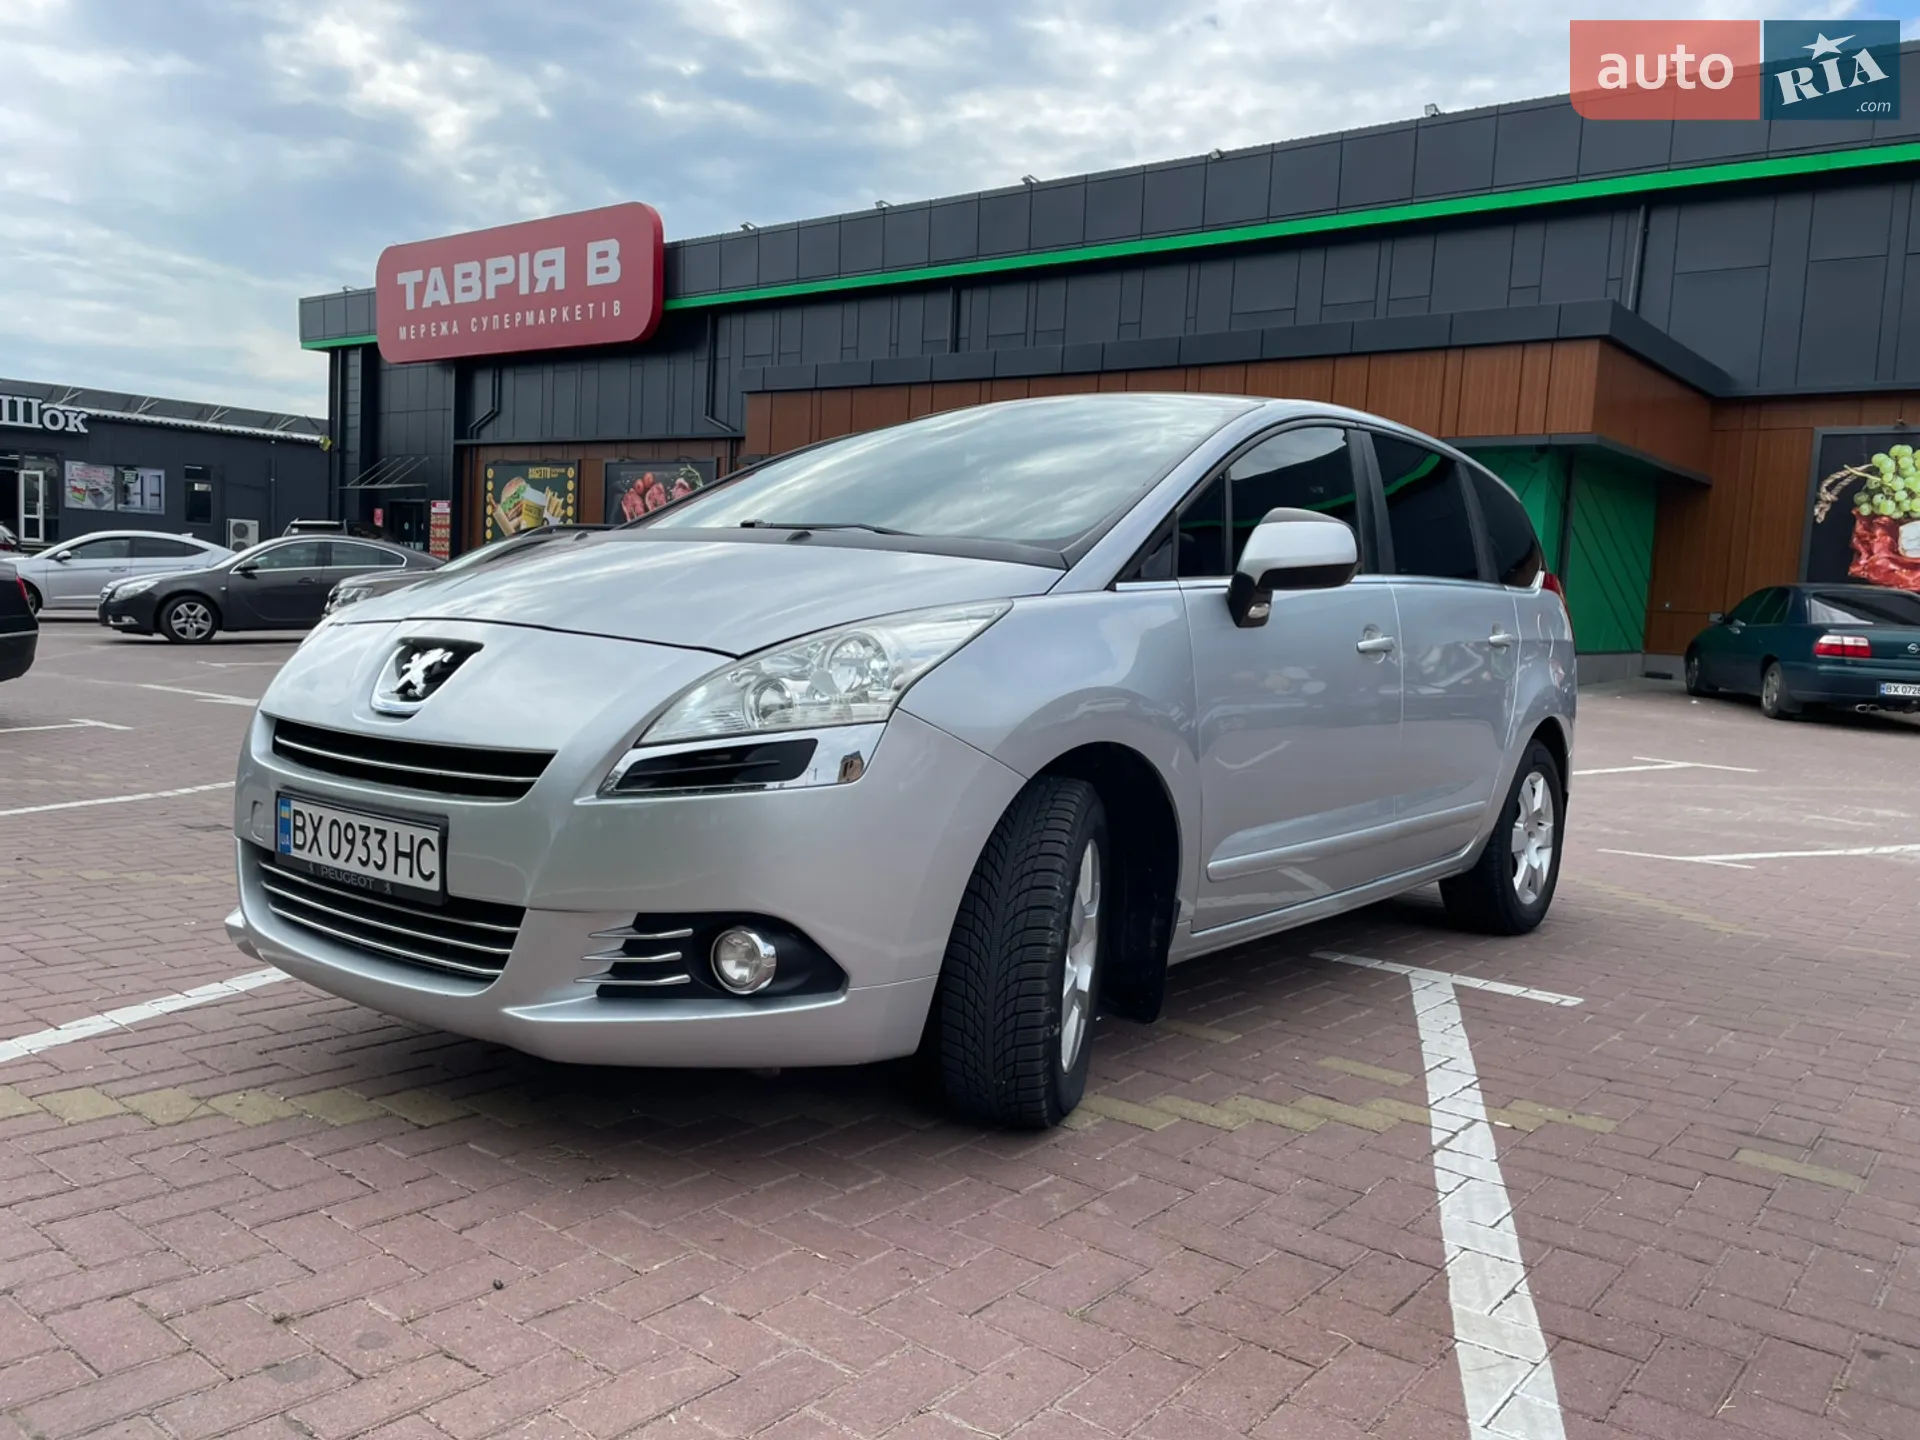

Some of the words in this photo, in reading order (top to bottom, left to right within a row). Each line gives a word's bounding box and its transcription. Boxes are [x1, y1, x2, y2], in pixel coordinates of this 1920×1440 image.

[397, 246, 566, 311] ТАВРІЯ
[586, 238, 622, 287] В
[398, 319, 460, 341] МЕРЕЖА
[470, 300, 622, 333] СУПЕРМАРКЕТІВ
[293, 809, 323, 857] BX
[328, 818, 387, 871] 0933
[394, 832, 436, 882] HC
[320, 866, 375, 890] PEUGEOT
